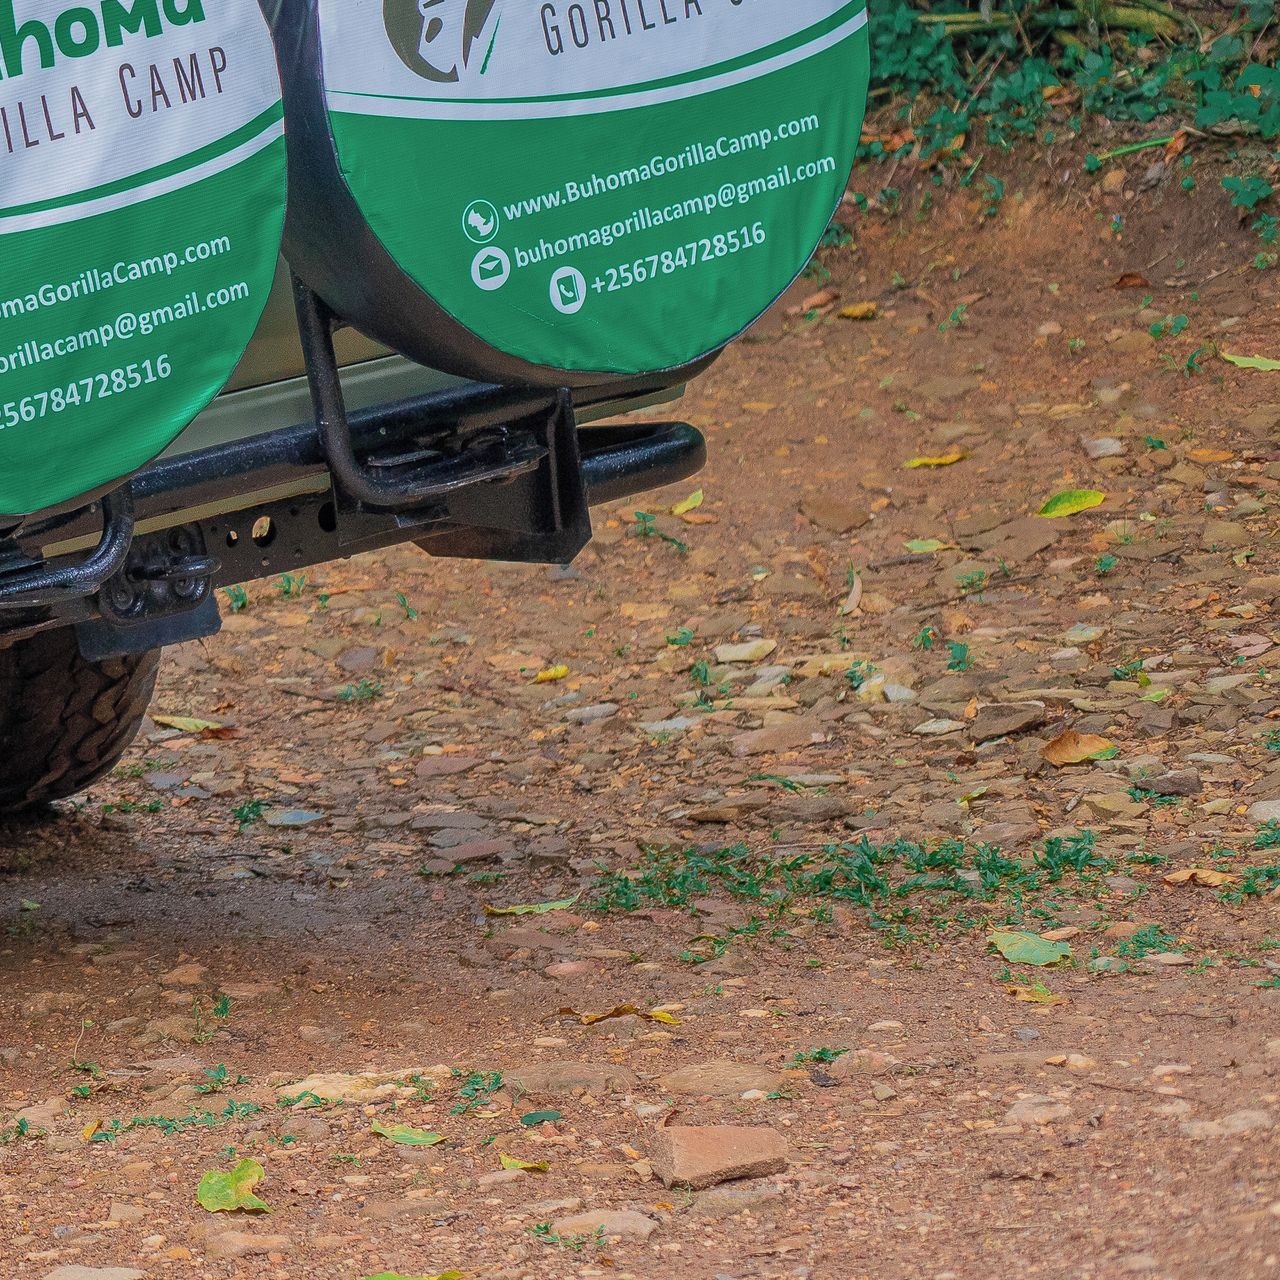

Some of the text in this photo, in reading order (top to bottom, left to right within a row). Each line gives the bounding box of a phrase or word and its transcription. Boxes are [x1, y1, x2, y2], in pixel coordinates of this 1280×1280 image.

[118, 46, 228, 119] CAMP
[503, 110, 821, 222] www.BuhomaGorillaCamp.com
[513, 153, 837, 269] buhomagorillacamp@gmail.com
[590, 221, 767, 296] +256784728516
